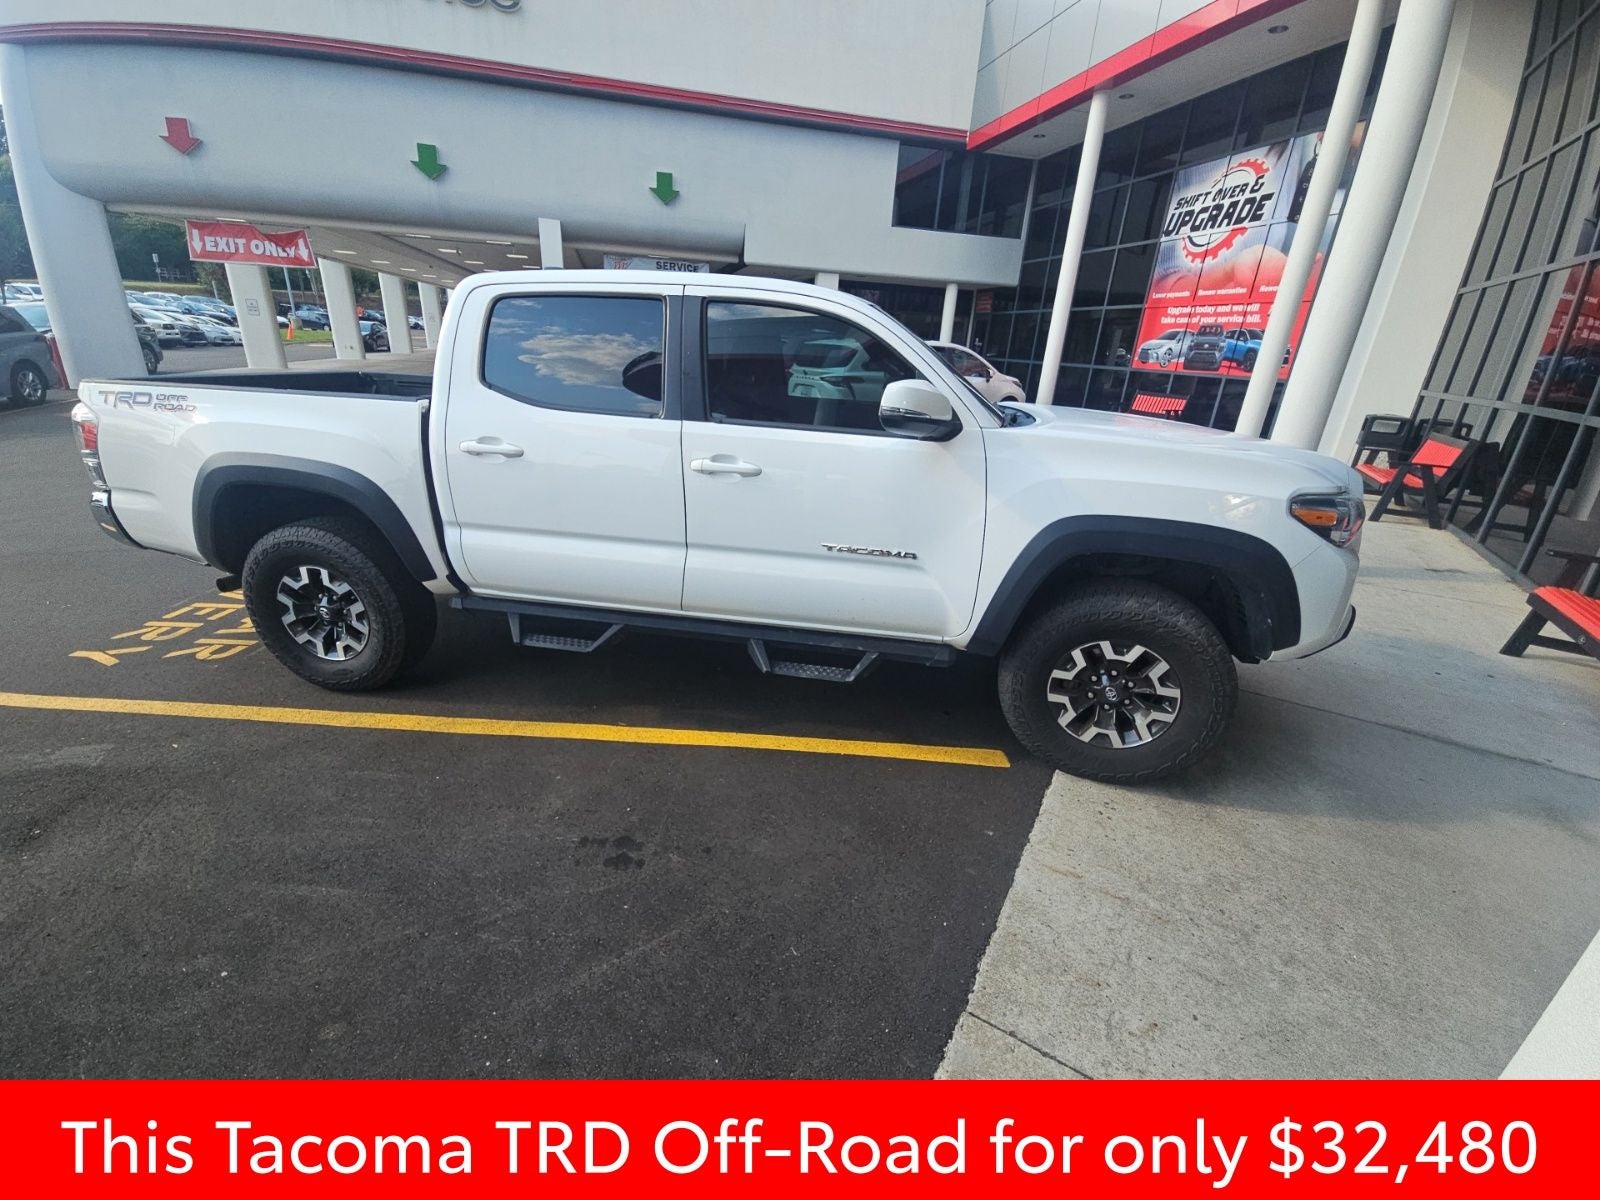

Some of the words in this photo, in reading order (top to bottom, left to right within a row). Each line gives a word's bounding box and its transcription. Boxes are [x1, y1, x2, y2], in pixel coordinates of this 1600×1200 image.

[1174, 191, 1212, 210] SHIFT
[1212, 182, 1250, 202] OVER
[1249, 174, 1265, 194] &
[1163, 192, 1275, 237] UPGRADE
[204, 236, 246, 253] EXIT
[250, 239, 296, 258] ONLY
[655, 261, 699, 273] SERVICE
[1196, 304, 1215, 314] today
[1216, 304, 1232, 312] and
[1161, 316, 1175, 324] take
[1200, 316, 1216, 326] your
[98, 390, 154, 409] TRD
[155, 393, 189, 403] OFF
[153, 402, 198, 413] ROAD
[820, 543, 918, 560] TACOMA
